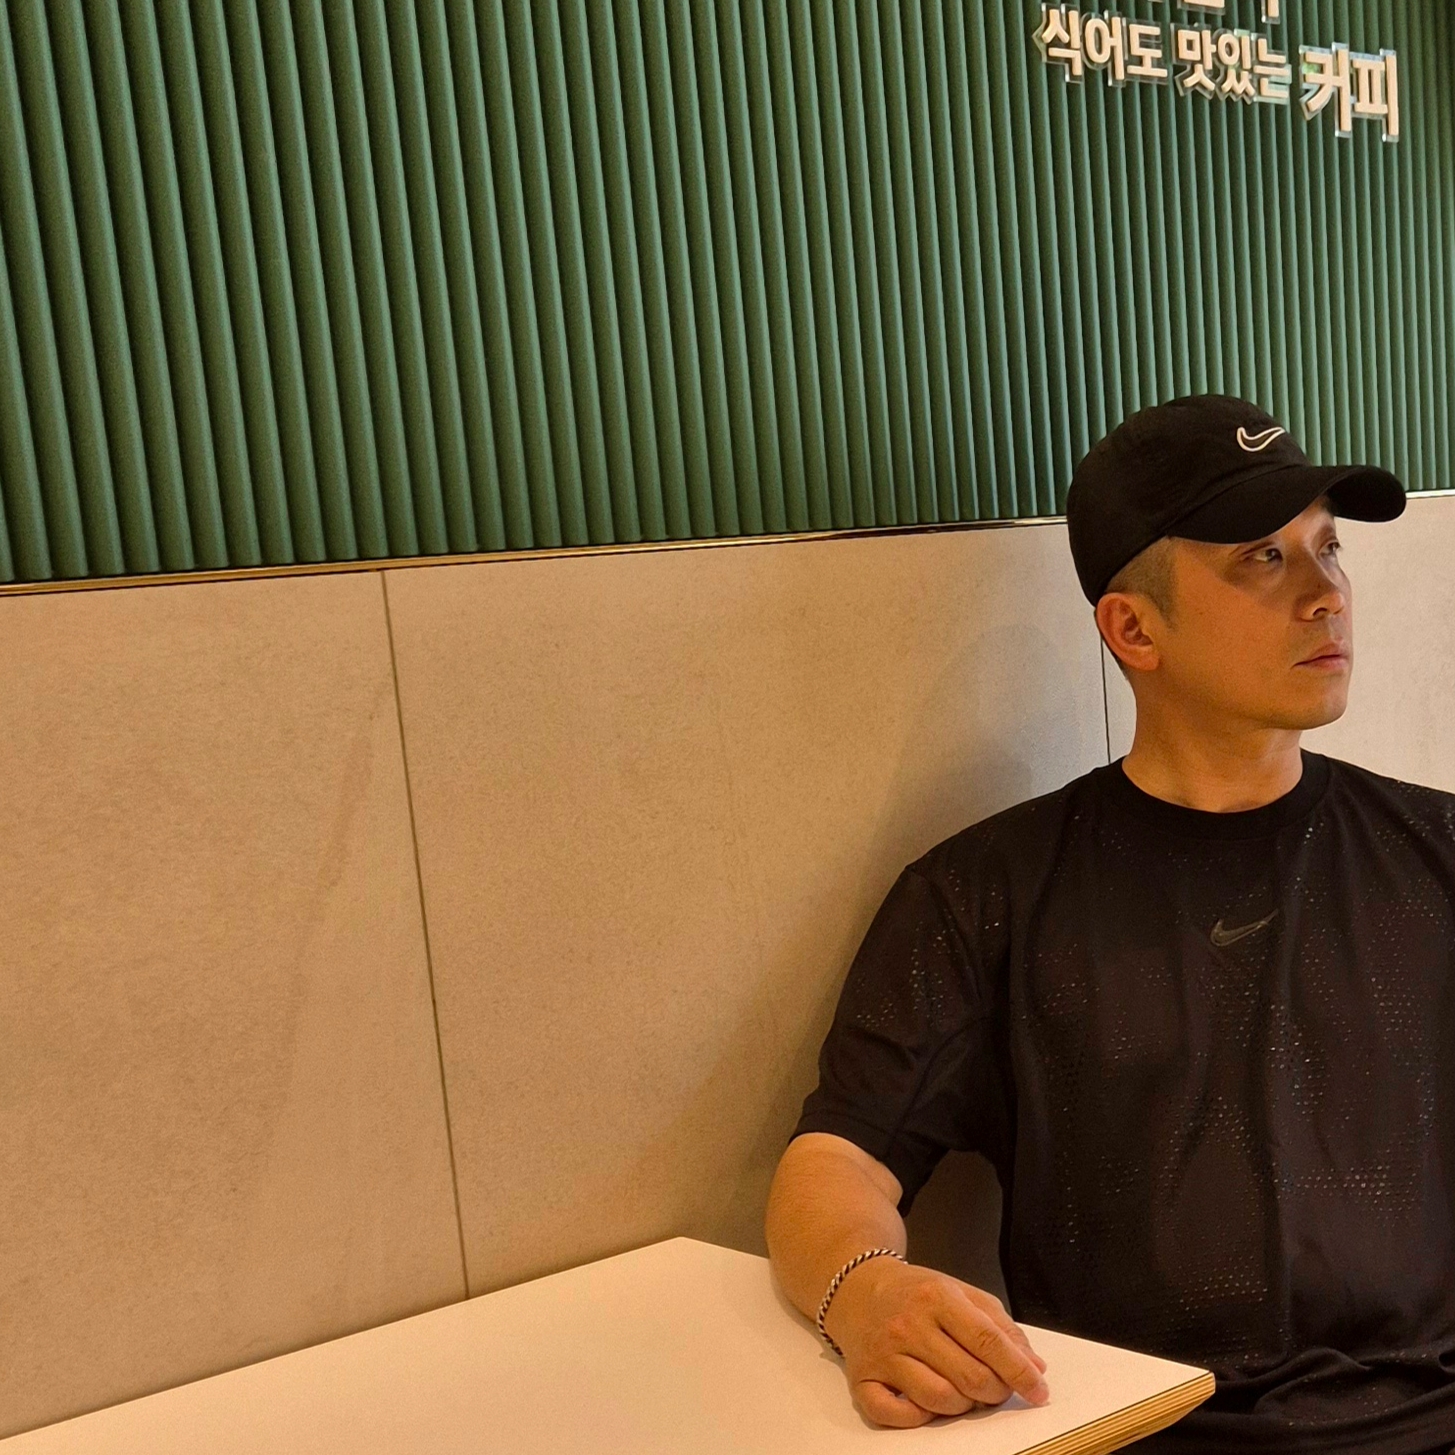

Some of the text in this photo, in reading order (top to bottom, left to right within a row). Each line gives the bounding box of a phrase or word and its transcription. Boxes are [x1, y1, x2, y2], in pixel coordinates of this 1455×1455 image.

[1041, 8, 1400, 137] 식어도 맛있는 커피
